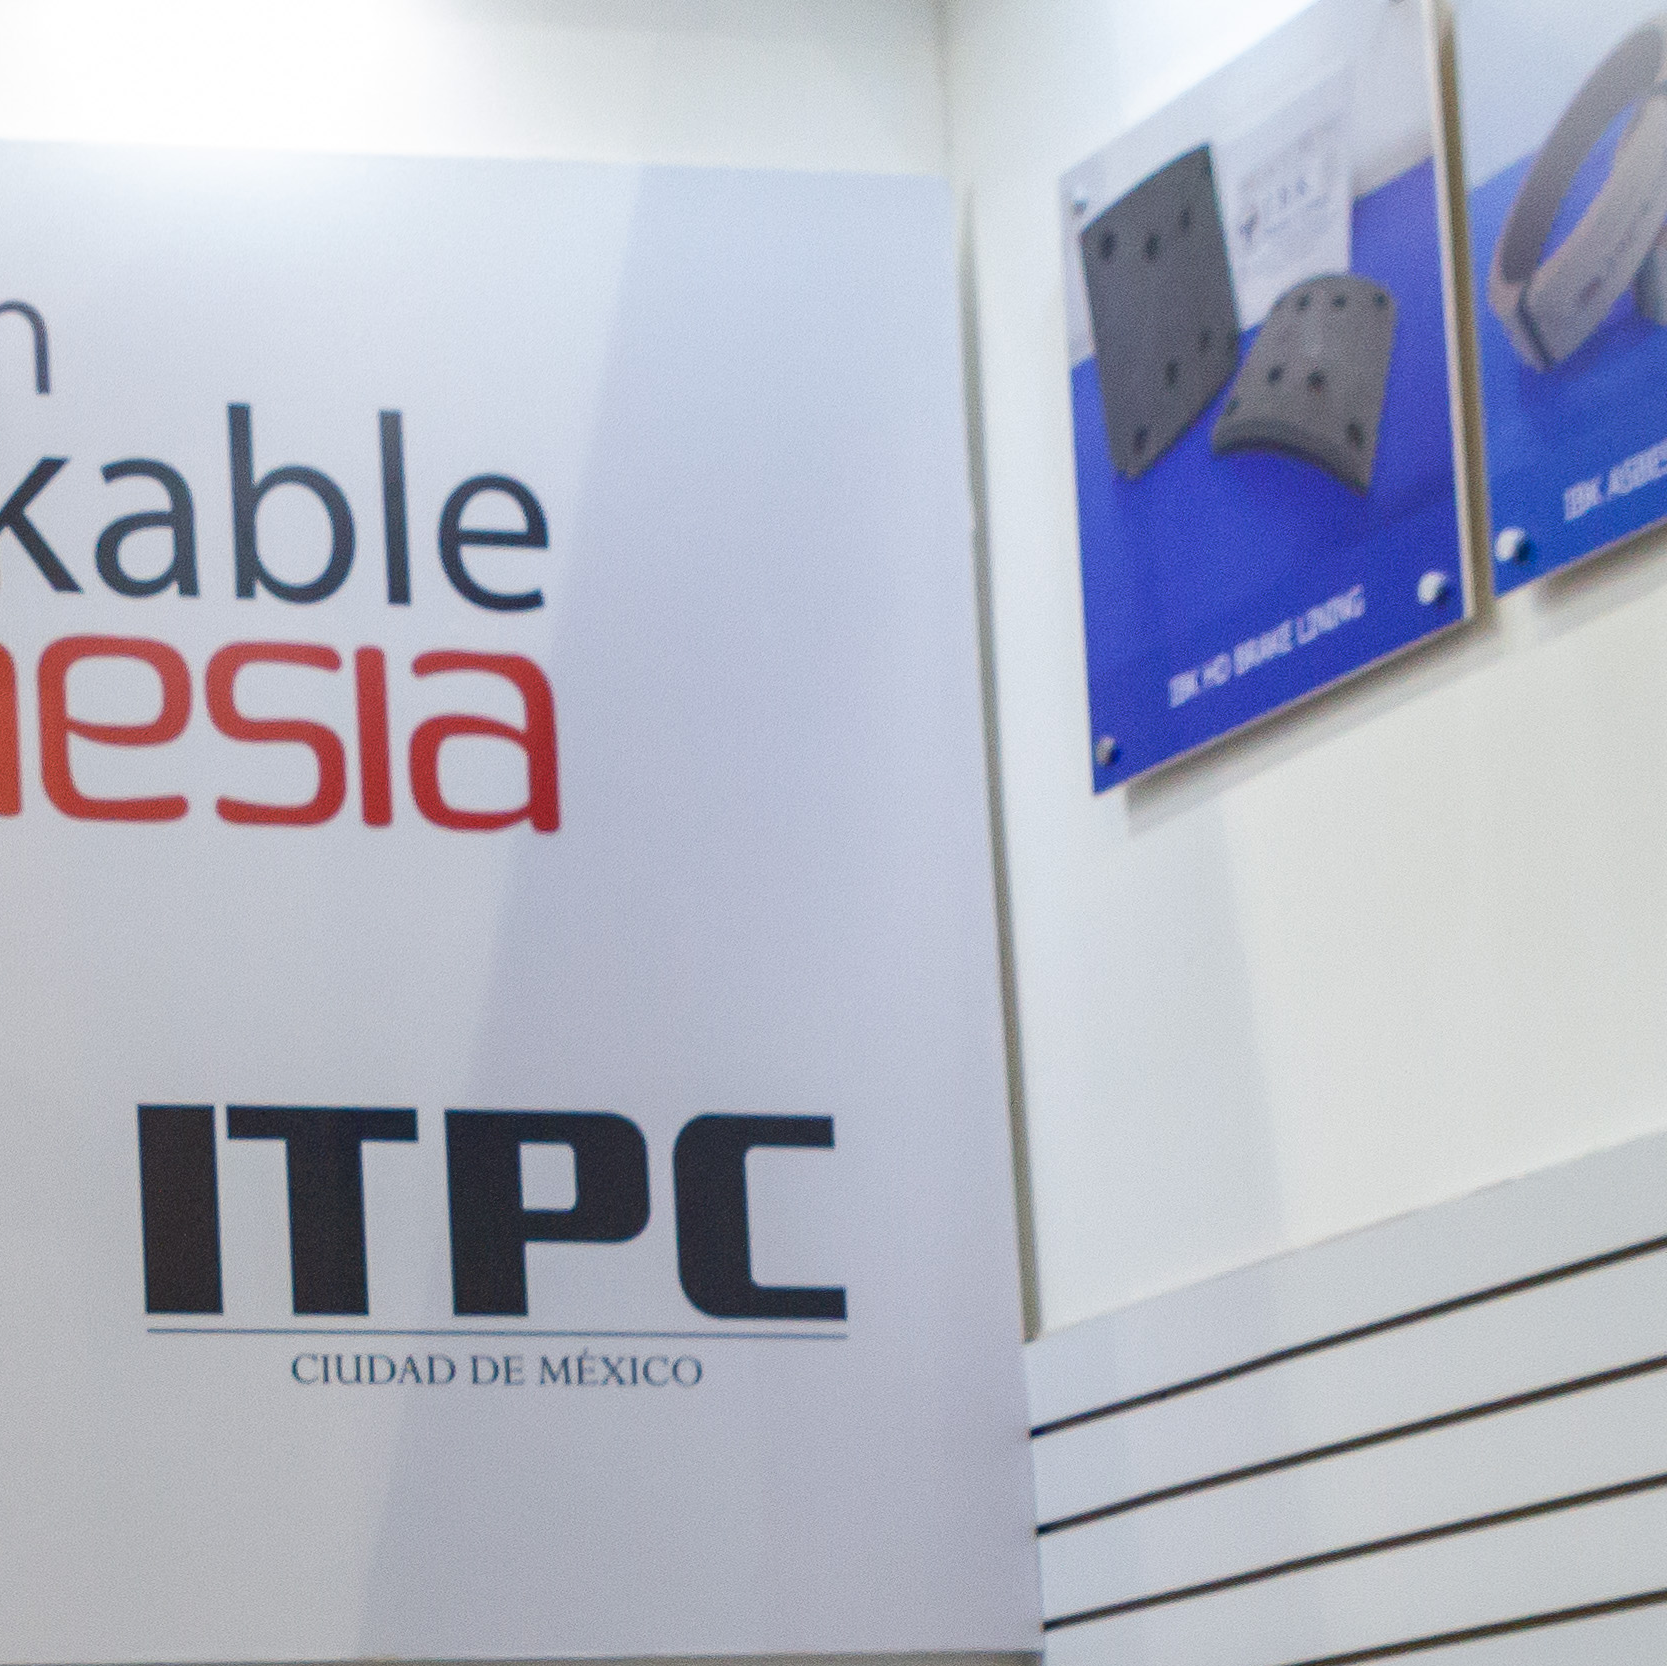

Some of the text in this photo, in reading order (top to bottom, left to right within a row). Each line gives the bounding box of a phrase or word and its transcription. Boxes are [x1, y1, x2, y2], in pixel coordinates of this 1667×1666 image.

[137, 1104, 848, 1321] ITPC
[291, 1348, 704, 1388] CIUDAD DE MÉXICO
